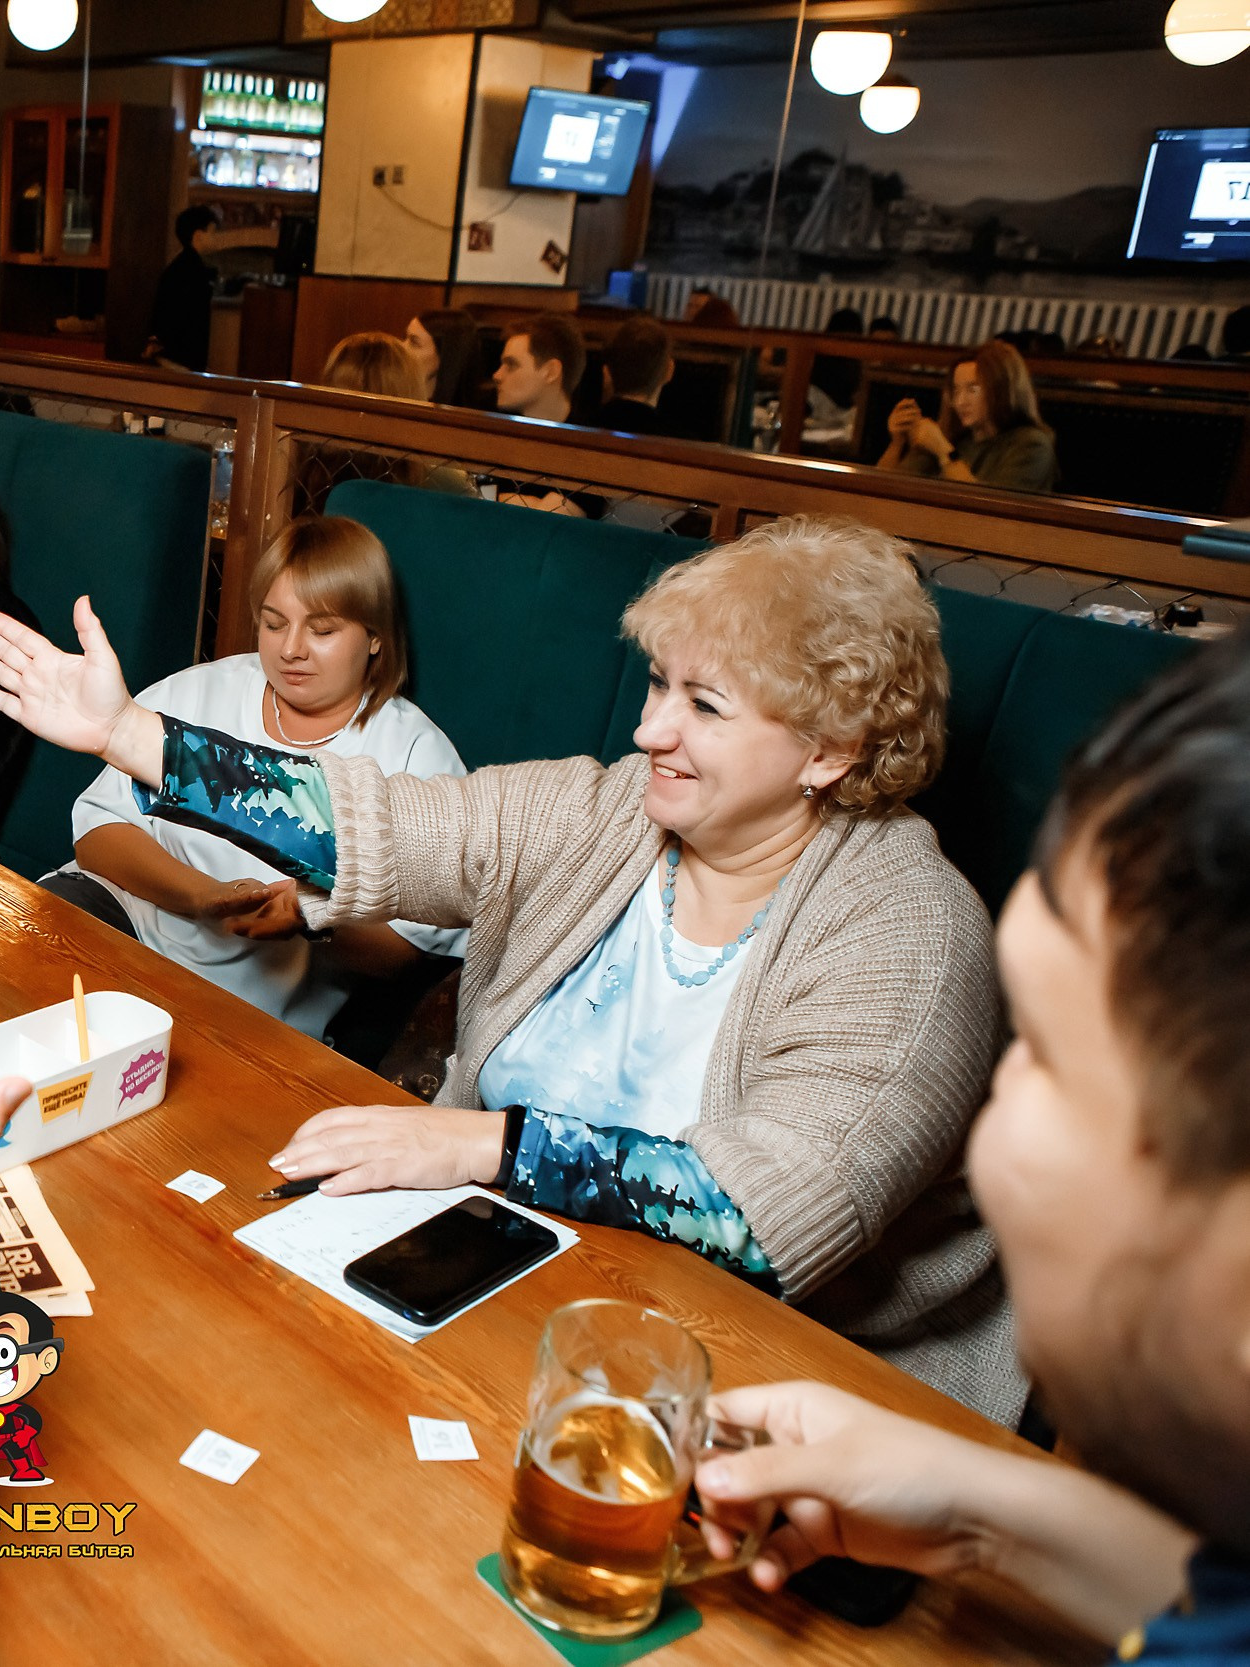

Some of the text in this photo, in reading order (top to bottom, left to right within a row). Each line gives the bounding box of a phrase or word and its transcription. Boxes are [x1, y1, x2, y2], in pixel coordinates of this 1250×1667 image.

[42, 1080, 88, 1105] ПРИНЕСИТЕ
[125, 1083, 135, 1094] НО
[3, 1246, 42, 1278] RE
